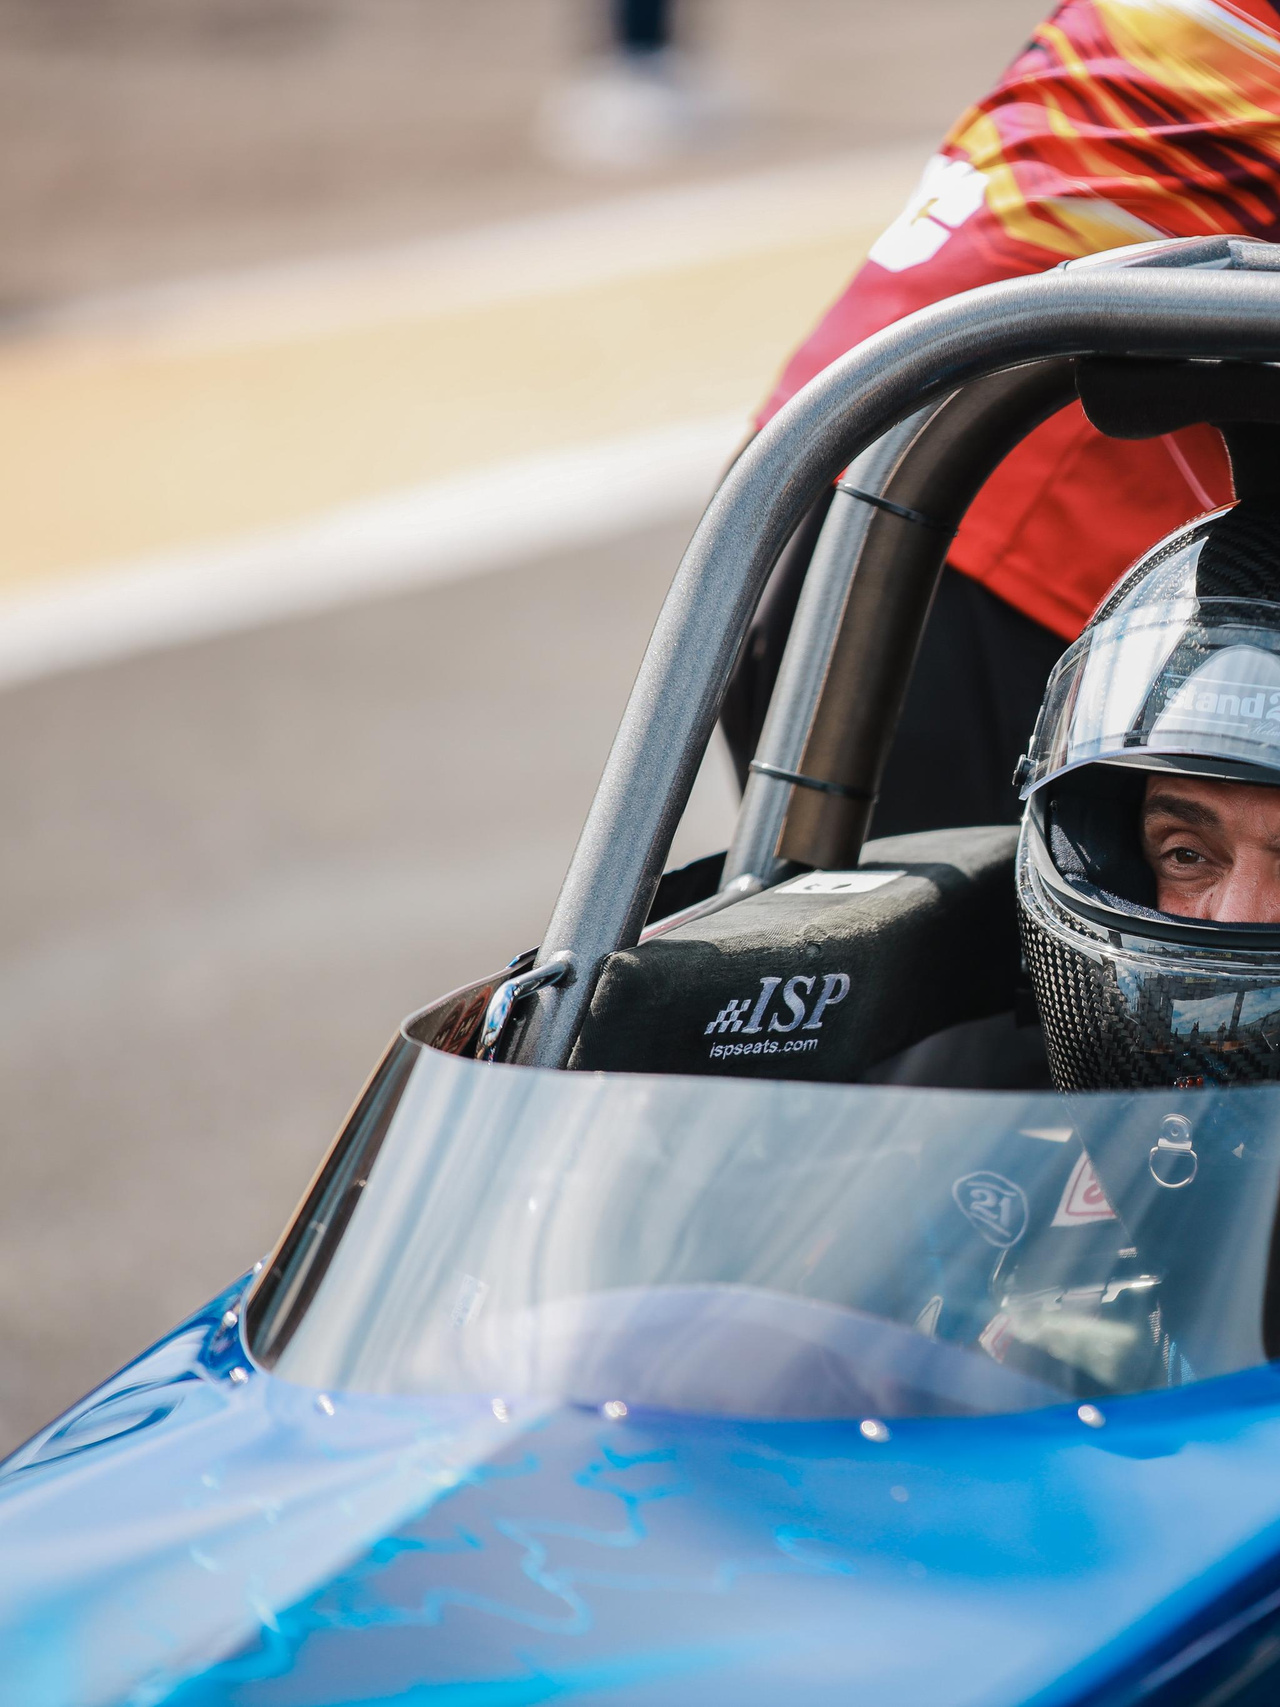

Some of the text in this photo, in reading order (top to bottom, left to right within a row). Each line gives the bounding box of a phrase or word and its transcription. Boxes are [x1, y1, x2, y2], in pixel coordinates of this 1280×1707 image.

[741, 972, 850, 1034] ISP
[709, 1038, 818, 1060] ispseats.com
[970, 1188, 1012, 1228] 21
